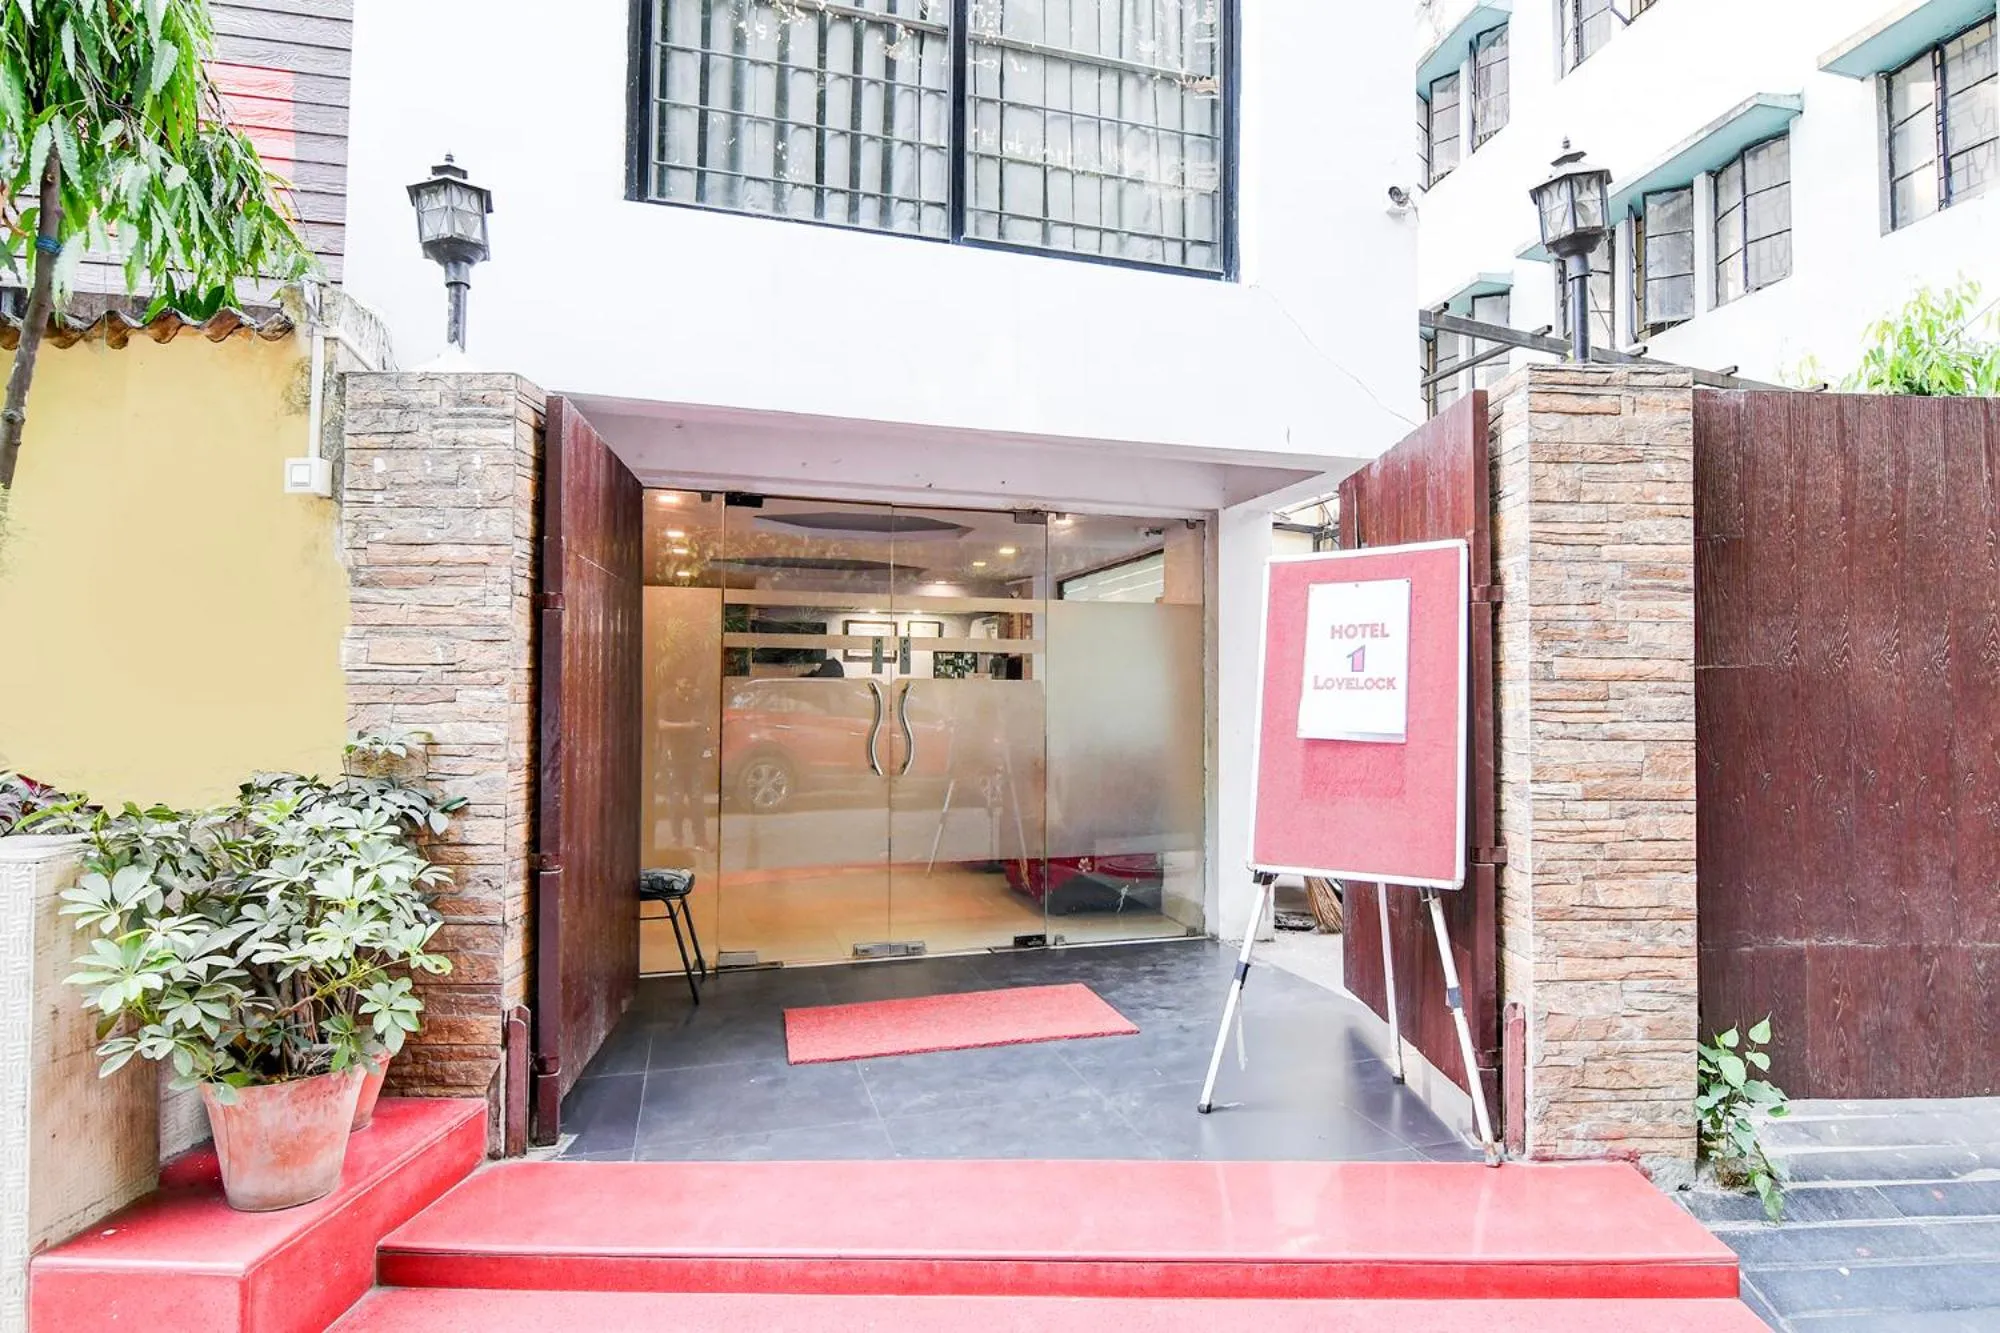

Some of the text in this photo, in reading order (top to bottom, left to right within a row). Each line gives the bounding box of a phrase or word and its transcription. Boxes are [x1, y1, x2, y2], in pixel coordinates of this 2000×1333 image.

[1330, 623, 1390, 640] HOTEL
[1346, 644, 1366, 673] 1
[1313, 675, 1397, 690] LOVELOCK
